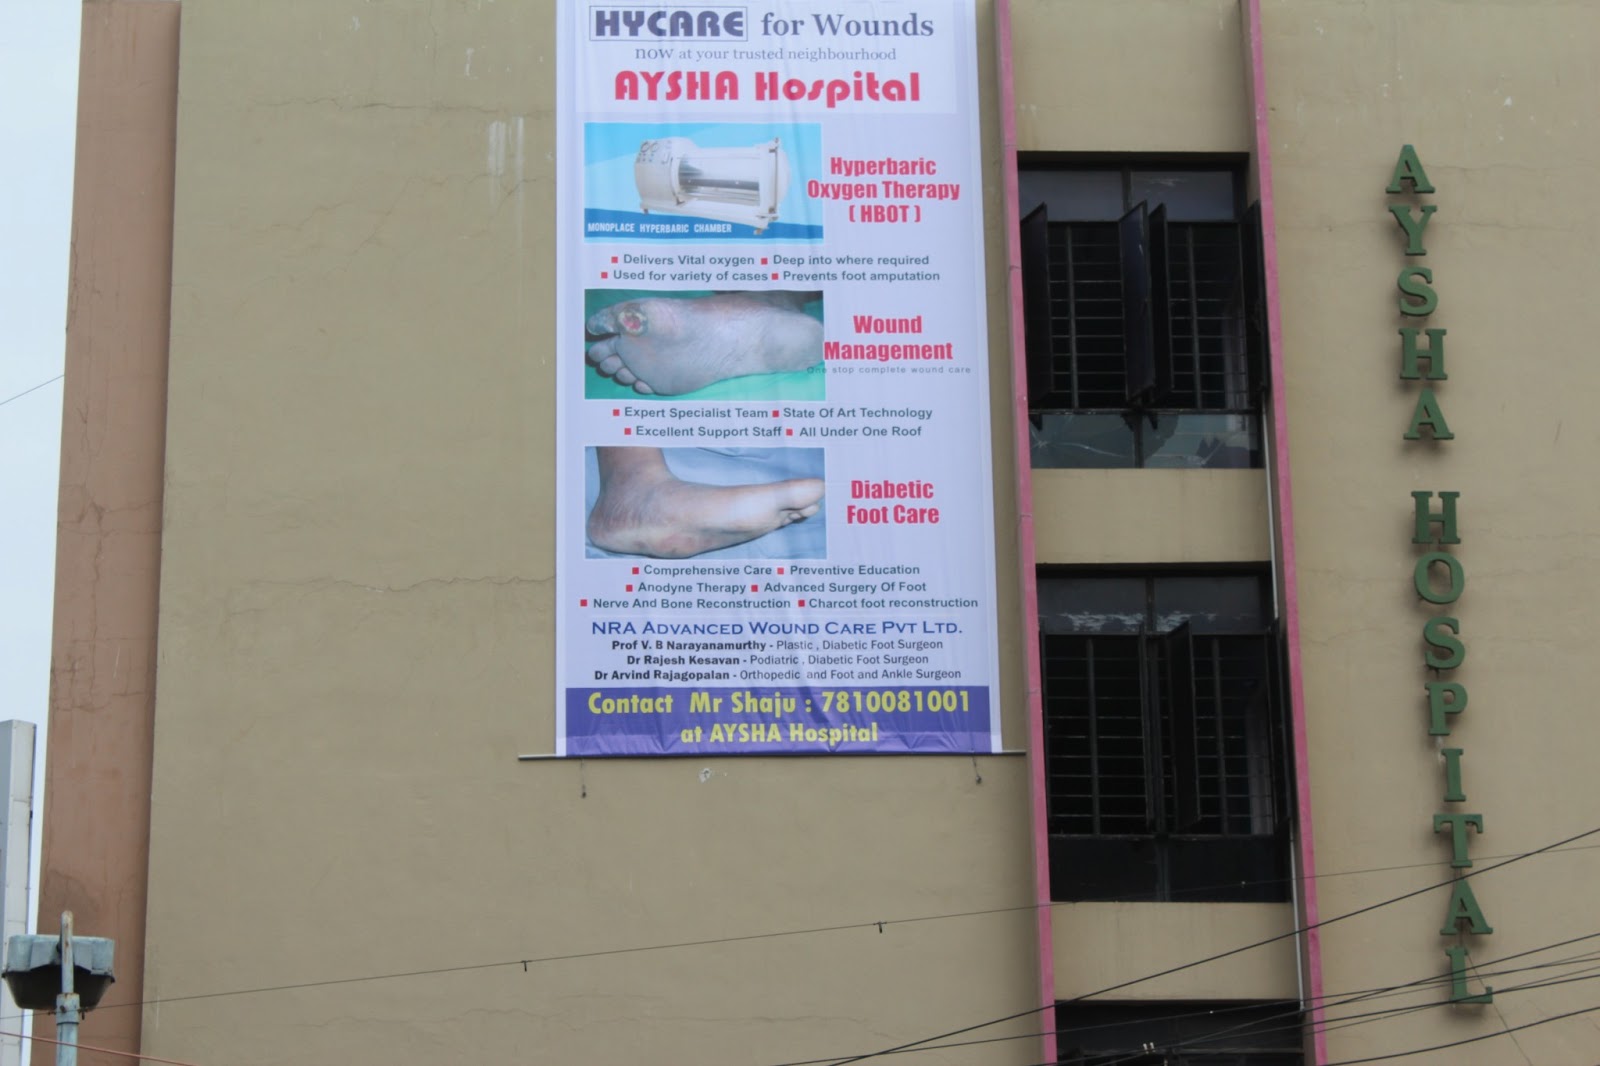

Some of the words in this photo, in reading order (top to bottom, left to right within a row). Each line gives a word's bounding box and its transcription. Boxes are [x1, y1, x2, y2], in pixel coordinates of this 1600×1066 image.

[595, 10, 744, 37] HYCARE
[761, 13, 804, 36] for
[814, 13, 934, 37] Wounds
[679, 49, 692, 60] at
[696, 50, 729, 63] your
[733, 48, 783, 60] trusted
[788, 48, 896, 62] neighbourhood
[614, 70, 738, 100] AYSHA
[755, 71, 920, 108] Hospital
[830, 156, 936, 177] Hyperbaric
[807, 180, 877, 200] Oxygen
[882, 180, 960, 201] Therapy
[860, 204, 909, 223] HBOT
[588, 223, 635, 232] MONOPLACE
[639, 223, 689, 233] HYPERBARIC
[694, 224, 732, 233] CHAMBER
[623, 254, 674, 265] Delivers
[678, 254, 705, 265] Vital
[709, 255, 755, 268] oxygen
[773, 254, 806, 268] Deep
[809, 254, 832, 265] into
[836, 254, 873, 265] where
[877, 254, 930, 267] required
[613, 270, 645, 281] Used
[649, 270, 666, 281] for
[669, 270, 714, 284] variety
[716, 270, 729, 282] of
[732, 272, 768, 281] cases
[783, 270, 838, 282] Prevents
[841, 270, 866, 281] foot
[869, 270, 940, 284] amputation
[1385, 143, 1455, 439] AYSHA
[853, 315, 922, 333] Wound
[824, 341, 953, 362] Management
[832, 367, 855, 375] stop
[859, 367, 906, 375] complete
[624, 407, 665, 420] Expert
[669, 407, 730, 420] Specialist
[733, 407, 769, 418] Team
[783, 407, 815, 418] State
[819, 408, 834, 418] Of
[837, 408, 855, 417] Art
[860, 407, 932, 419] Technology
[636, 426, 695, 437] Excellent
[698, 426, 748, 440] Support
[752, 425, 782, 437] Staff
[800, 427, 816, 436] All
[820, 426, 858, 436] Under
[862, 427, 887, 436] One
[892, 426, 921, 436] Roof
[850, 480, 934, 500] Diabetic
[846, 505, 890, 524] Foot
[893, 505, 939, 524] Care
[644, 565, 740, 577] Comprehensive
[744, 565, 772, 575] Care
[790, 566, 854, 575] Preventive
[858, 565, 920, 575] Education
[638, 582, 693, 595] Anodyne
[697, 583, 746, 594] Therapy
[764, 582, 824, 592] Advanced
[829, 583, 876, 594] Surgery
[881, 582, 895, 591] Of
[899, 582, 926, 591] Foot
[593, 599, 629, 608] Nerve
[632, 599, 657, 608] And
[661, 599, 693, 608] Bone
[700, 598, 790, 610] Reconstruction
[809, 599, 857, 609] Charcot
[861, 598, 885, 608] foot
[889, 598, 978, 608] reconstruction
[592, 621, 636, 635] NRA
[612, 640, 637, 650] Prof
[641, 640, 651, 650] V.
[655, 640, 663, 649] B
[667, 640, 766, 652] Narayanamurthy
[776, 640, 813, 650] Plastic
[823, 640, 868, 650] Diabetic
[871, 640, 894, 649] Foot
[898, 640, 943, 651] Surgeon
[627, 656, 640, 664] Dr
[644, 655, 685, 666] Rajesh
[689, 655, 740, 665] Kesavan
[750, 654, 798, 666] Podiatric
[808, 655, 853, 664] Diabetic
[857, 655, 880, 664] Foot
[883, 655, 928, 666] Surgeon
[595, 670, 608, 680] Dr
[611, 670, 650, 680] Arvind
[654, 670, 730, 682] Rajagopalan
[740, 669, 800, 682] Orthopedic
[807, 670, 827, 679] and
[831, 669, 854, 679] Foot
[858, 669, 878, 679] and
[882, 669, 912, 679] Ankle
[916, 669, 961, 680] Surgeon
[589, 692, 673, 714] Contact
[690, 693, 723, 713] Mr
[732, 691, 796, 718] Shaju
[822, 691, 969, 714] 7810081001
[681, 726, 702, 743] at
[710, 724, 782, 743] AYSHA
[790, 722, 878, 746] Hospital
[1410, 490, 1494, 1004] HOSPITAL
